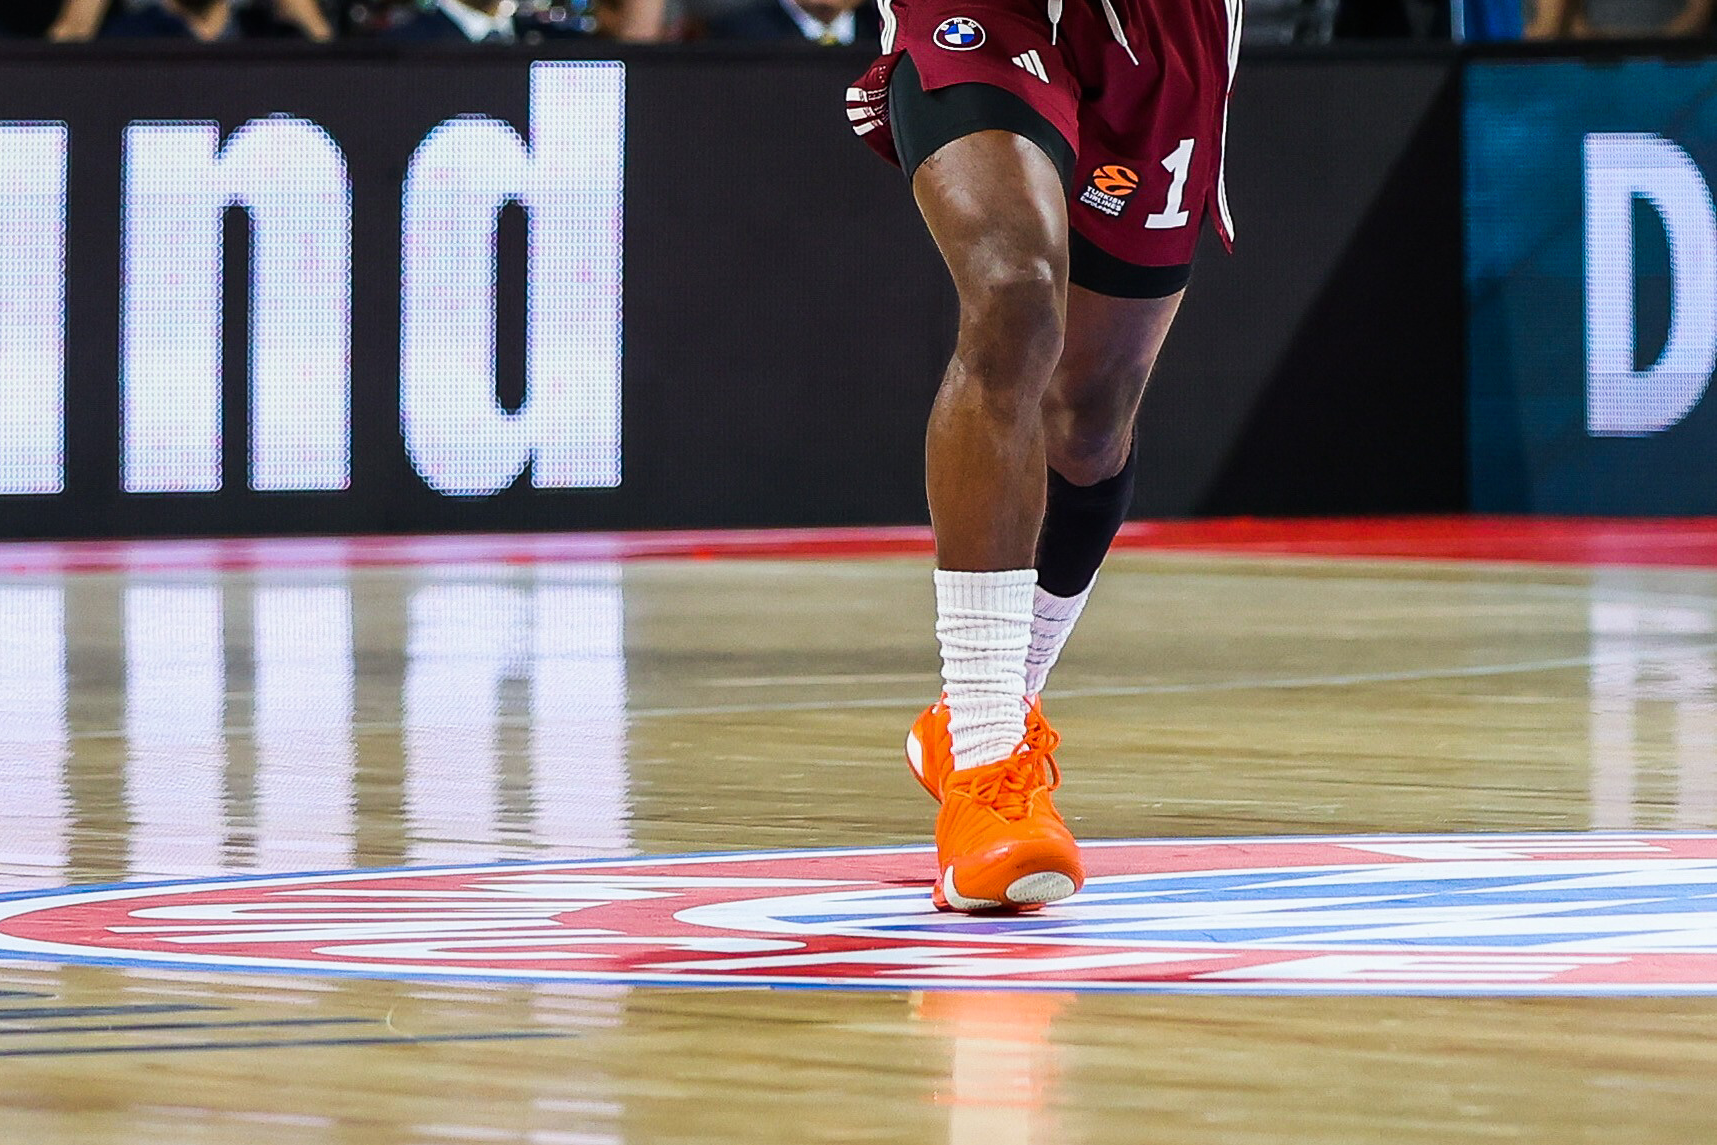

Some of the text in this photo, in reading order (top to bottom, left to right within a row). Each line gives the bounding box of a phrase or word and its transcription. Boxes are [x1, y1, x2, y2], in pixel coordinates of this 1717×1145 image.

[940, 19, 977, 30] BMW
[1144, 138, 1195, 229] 1
[1083, 192, 1122, 211] AIRLINES
[1087, 186, 1125, 206] TURKISH
[1586, 132, 1717, 437] D
